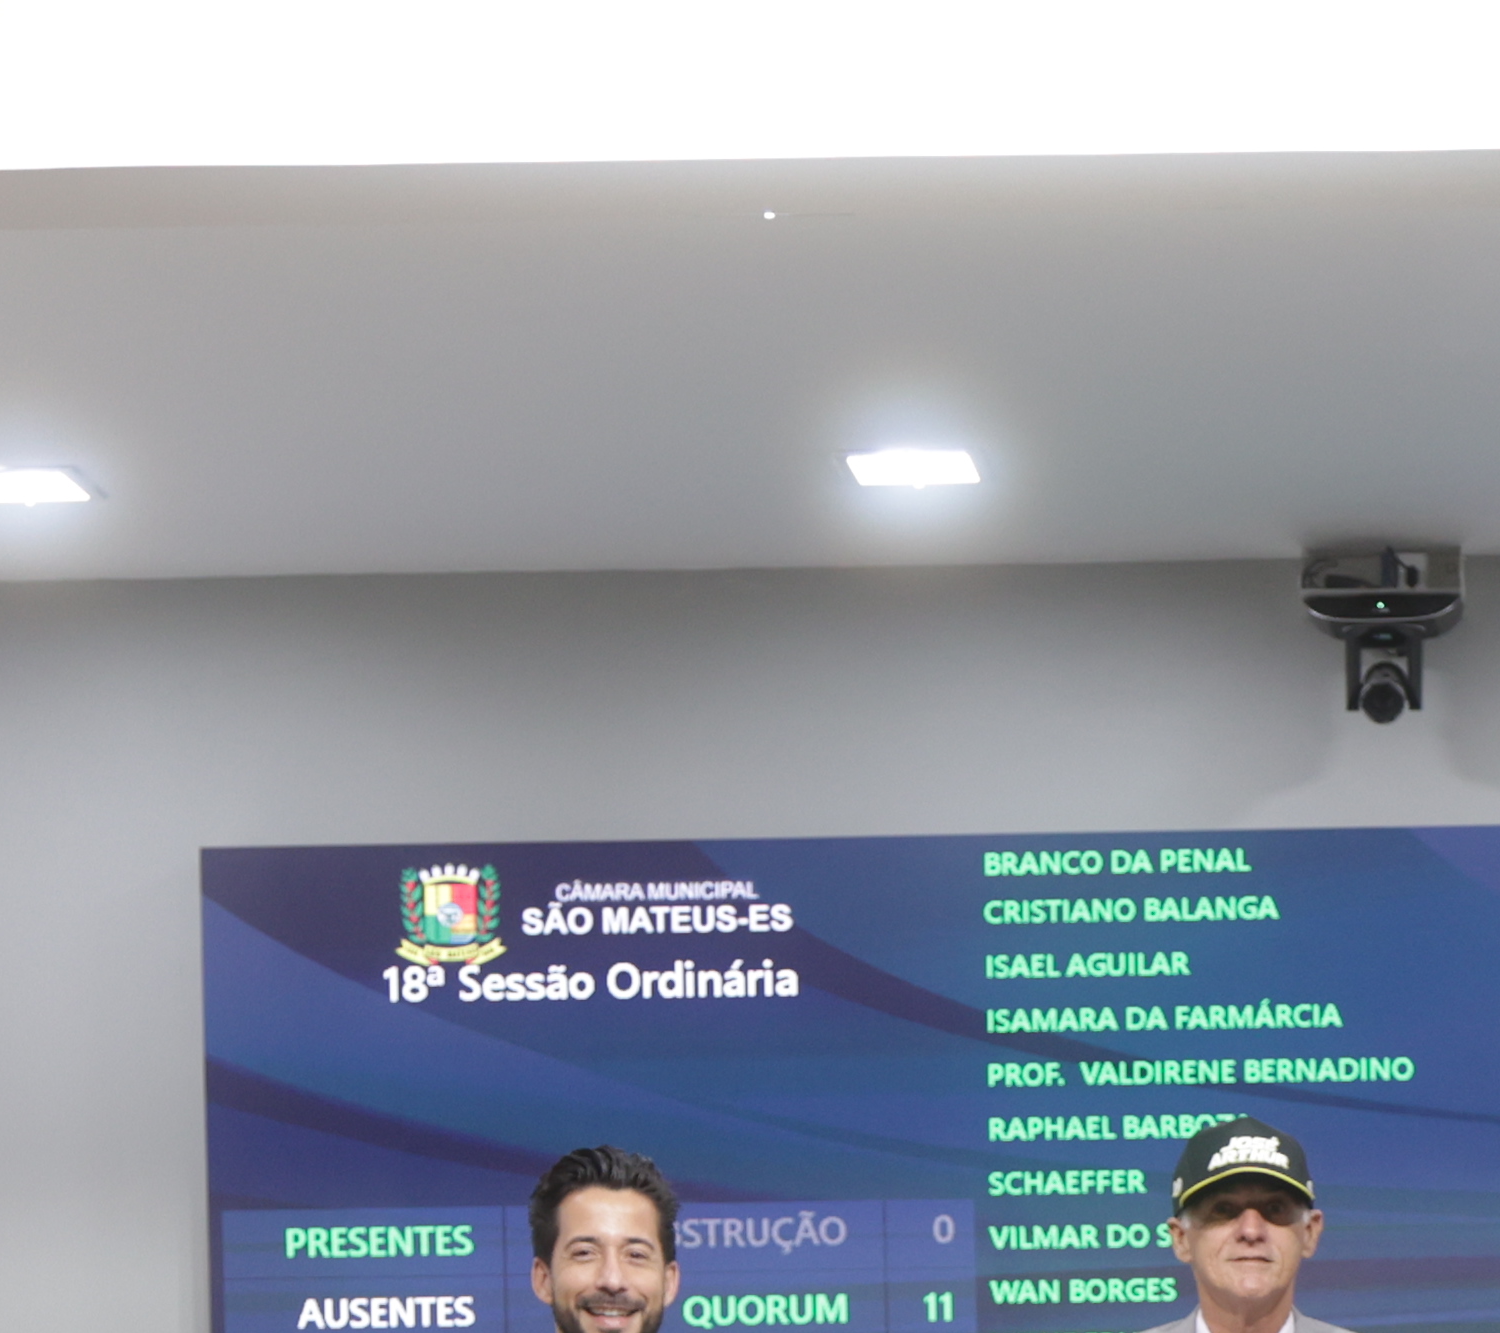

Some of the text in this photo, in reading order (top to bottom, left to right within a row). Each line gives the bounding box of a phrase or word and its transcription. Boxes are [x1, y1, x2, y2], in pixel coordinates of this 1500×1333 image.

[983, 847, 1253, 877] BRANCO DA PENAL
[556, 880, 759, 901] CÂMARA MUNICIPAL
[521, 901, 794, 936] SÃO MATEUS-ES
[982, 894, 1281, 926] CRISTIANO BALANGA
[984, 951, 1192, 980] ISAEL AGUILAR
[382, 959, 799, 1003] 18ª Sessão Ordinária
[986, 998, 1344, 1034] ISAMARA DA FARMÁRCIA
[986, 1056, 1416, 1088] PROF. VALDIRENE BERNADINO
[987, 1112, 1249, 1142] RAPHAEL BARBO
[1219, 1136, 1280, 1153] JOSÉ
[1208, 1149, 1289, 1171] ARTHUR
[987, 1168, 1149, 1197] SCHAEFFER
[284, 1224, 475, 1259] PRESENTES
[932, 1214, 956, 1244] 0
[987, 1223, 1102, 1251] VILMAR
[1105, 1222, 1152, 1249] DO
[988, 1276, 1179, 1305] WAN BORGES
[297, 1295, 476, 1330] AUSENTES
[682, 1291, 955, 1330] QUORUM 11
